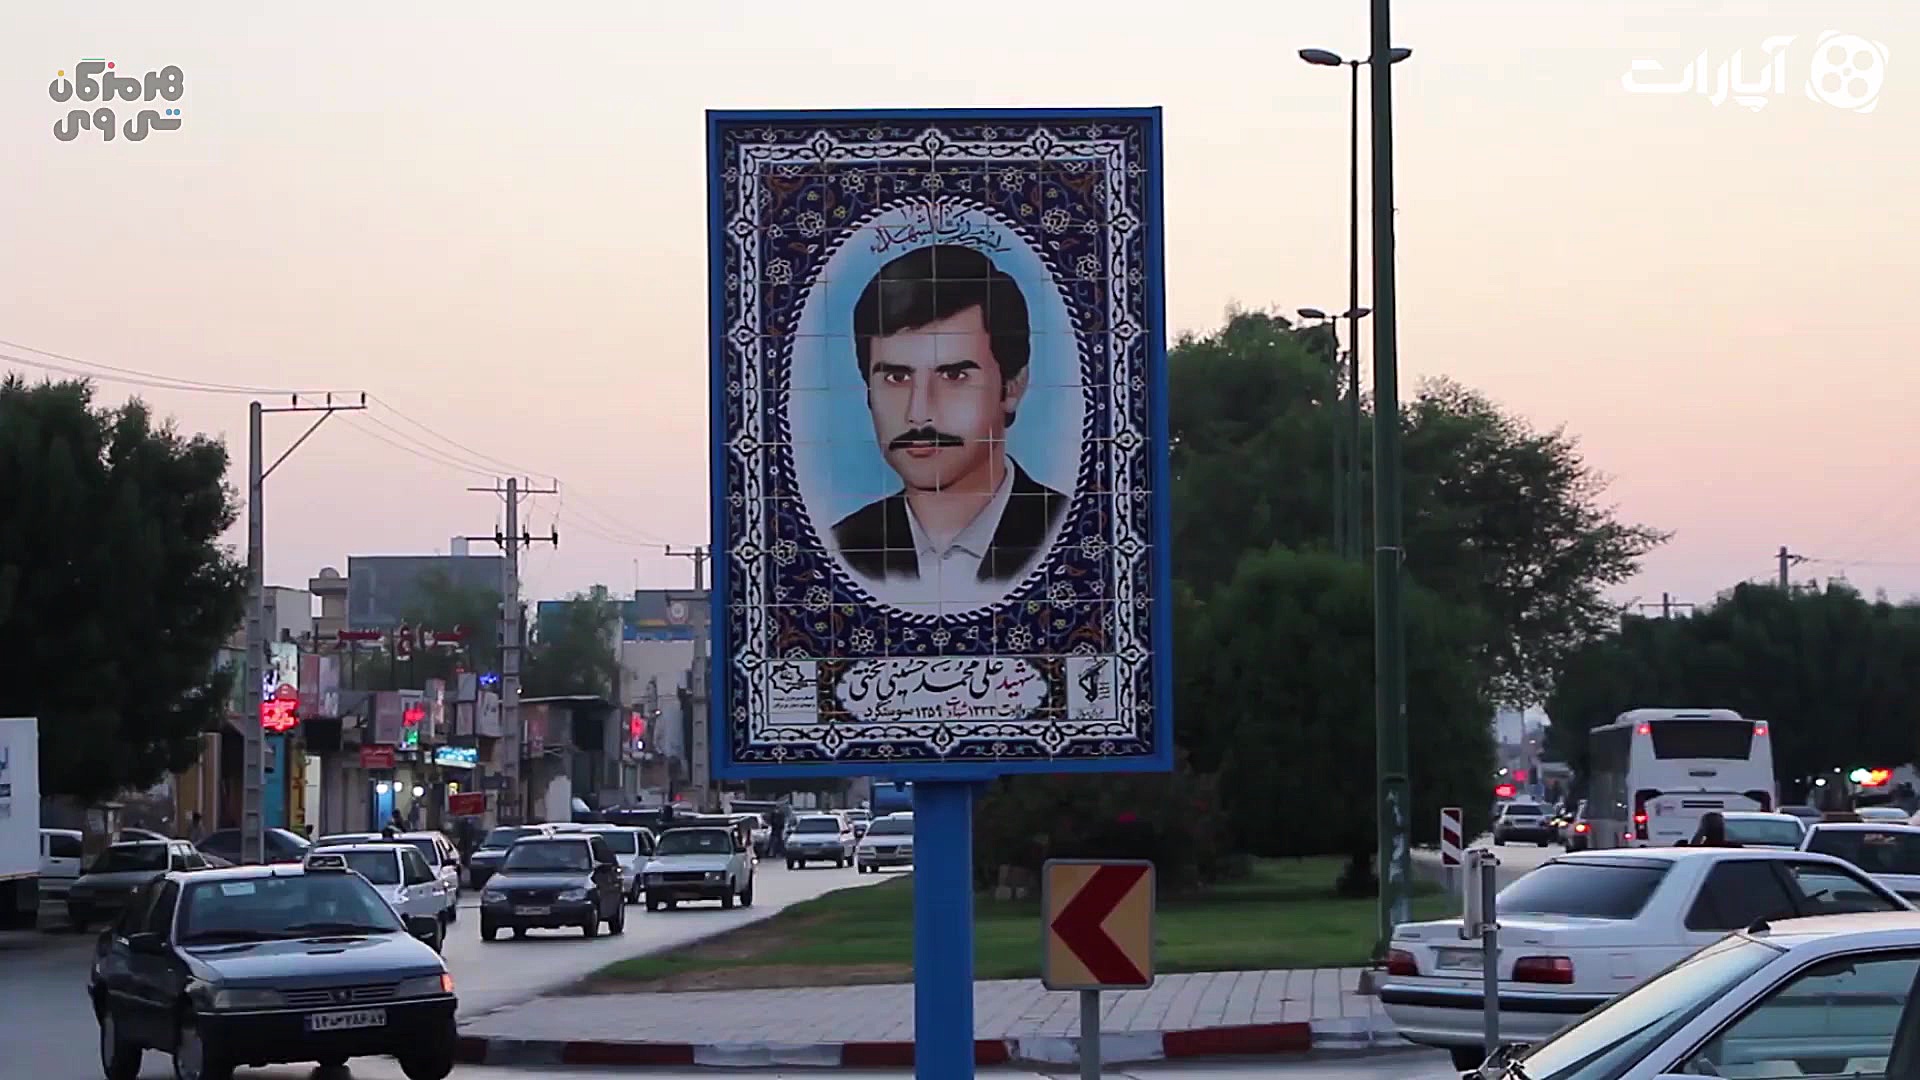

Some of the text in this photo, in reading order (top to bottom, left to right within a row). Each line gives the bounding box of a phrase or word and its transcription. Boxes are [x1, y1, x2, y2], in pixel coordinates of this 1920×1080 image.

[912, 659, 980, 693] محمد
[969, 658, 1004, 700] علی
[996, 661, 1036, 698] شهید
